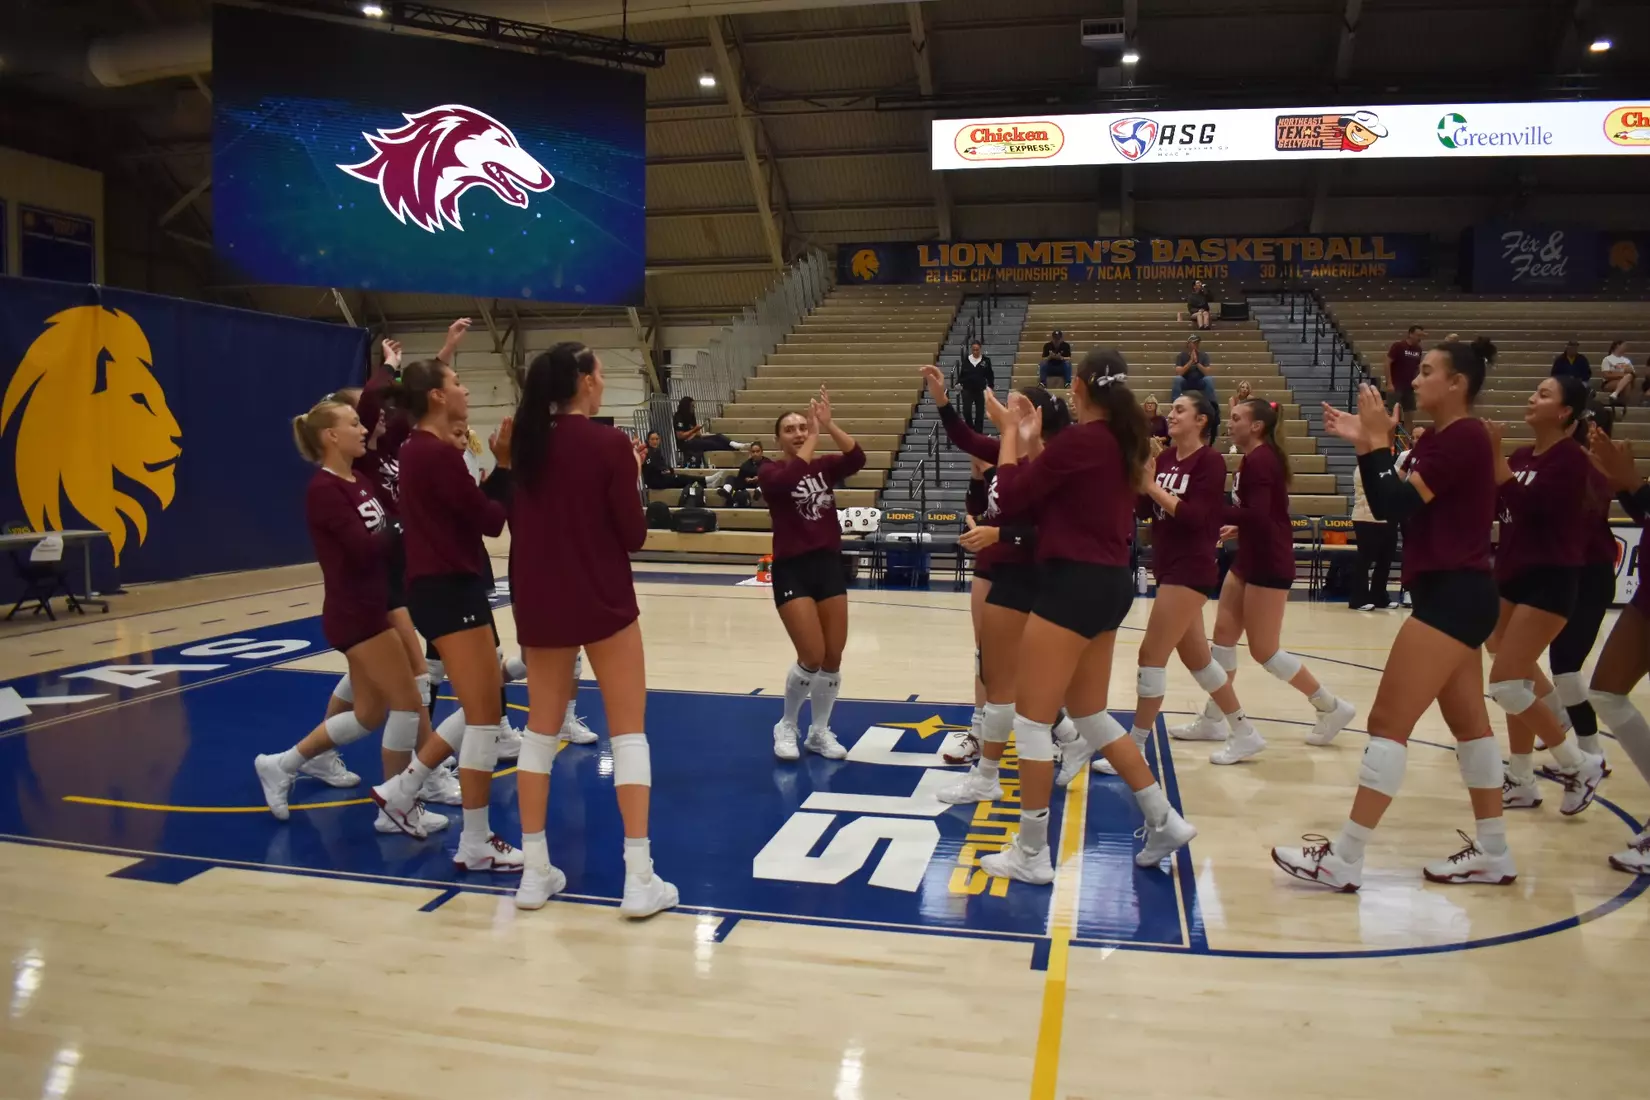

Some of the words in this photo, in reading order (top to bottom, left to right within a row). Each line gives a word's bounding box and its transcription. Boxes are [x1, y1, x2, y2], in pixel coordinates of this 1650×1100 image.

[1278, 117, 1322, 126] NORTHEAST
[970, 127, 1048, 143] Chicken
[1159, 123, 1216, 146] ASG
[1279, 126, 1321, 139] TEXAS
[1453, 125, 1553, 147] Greenville
[1009, 144, 1050, 153] EXPRESS
[917, 242, 1003, 267] LION
[1016, 239, 1137, 265] MEN'S
[1150, 236, 1396, 263] BASKETBALL
[1501, 231, 1540, 259] Fix
[1540, 231, 1564, 262] &
[944, 270, 966, 284] LSC
[1086, 266, 1094, 280] 7
[1098, 265, 1131, 280] NCAA
[1136, 264, 1228, 280] TOURNAMENTS
[1260, 264, 1276, 278] 30
[1510, 254, 1569, 282] Feed
[1324, 520, 1354, 528] LIONS
